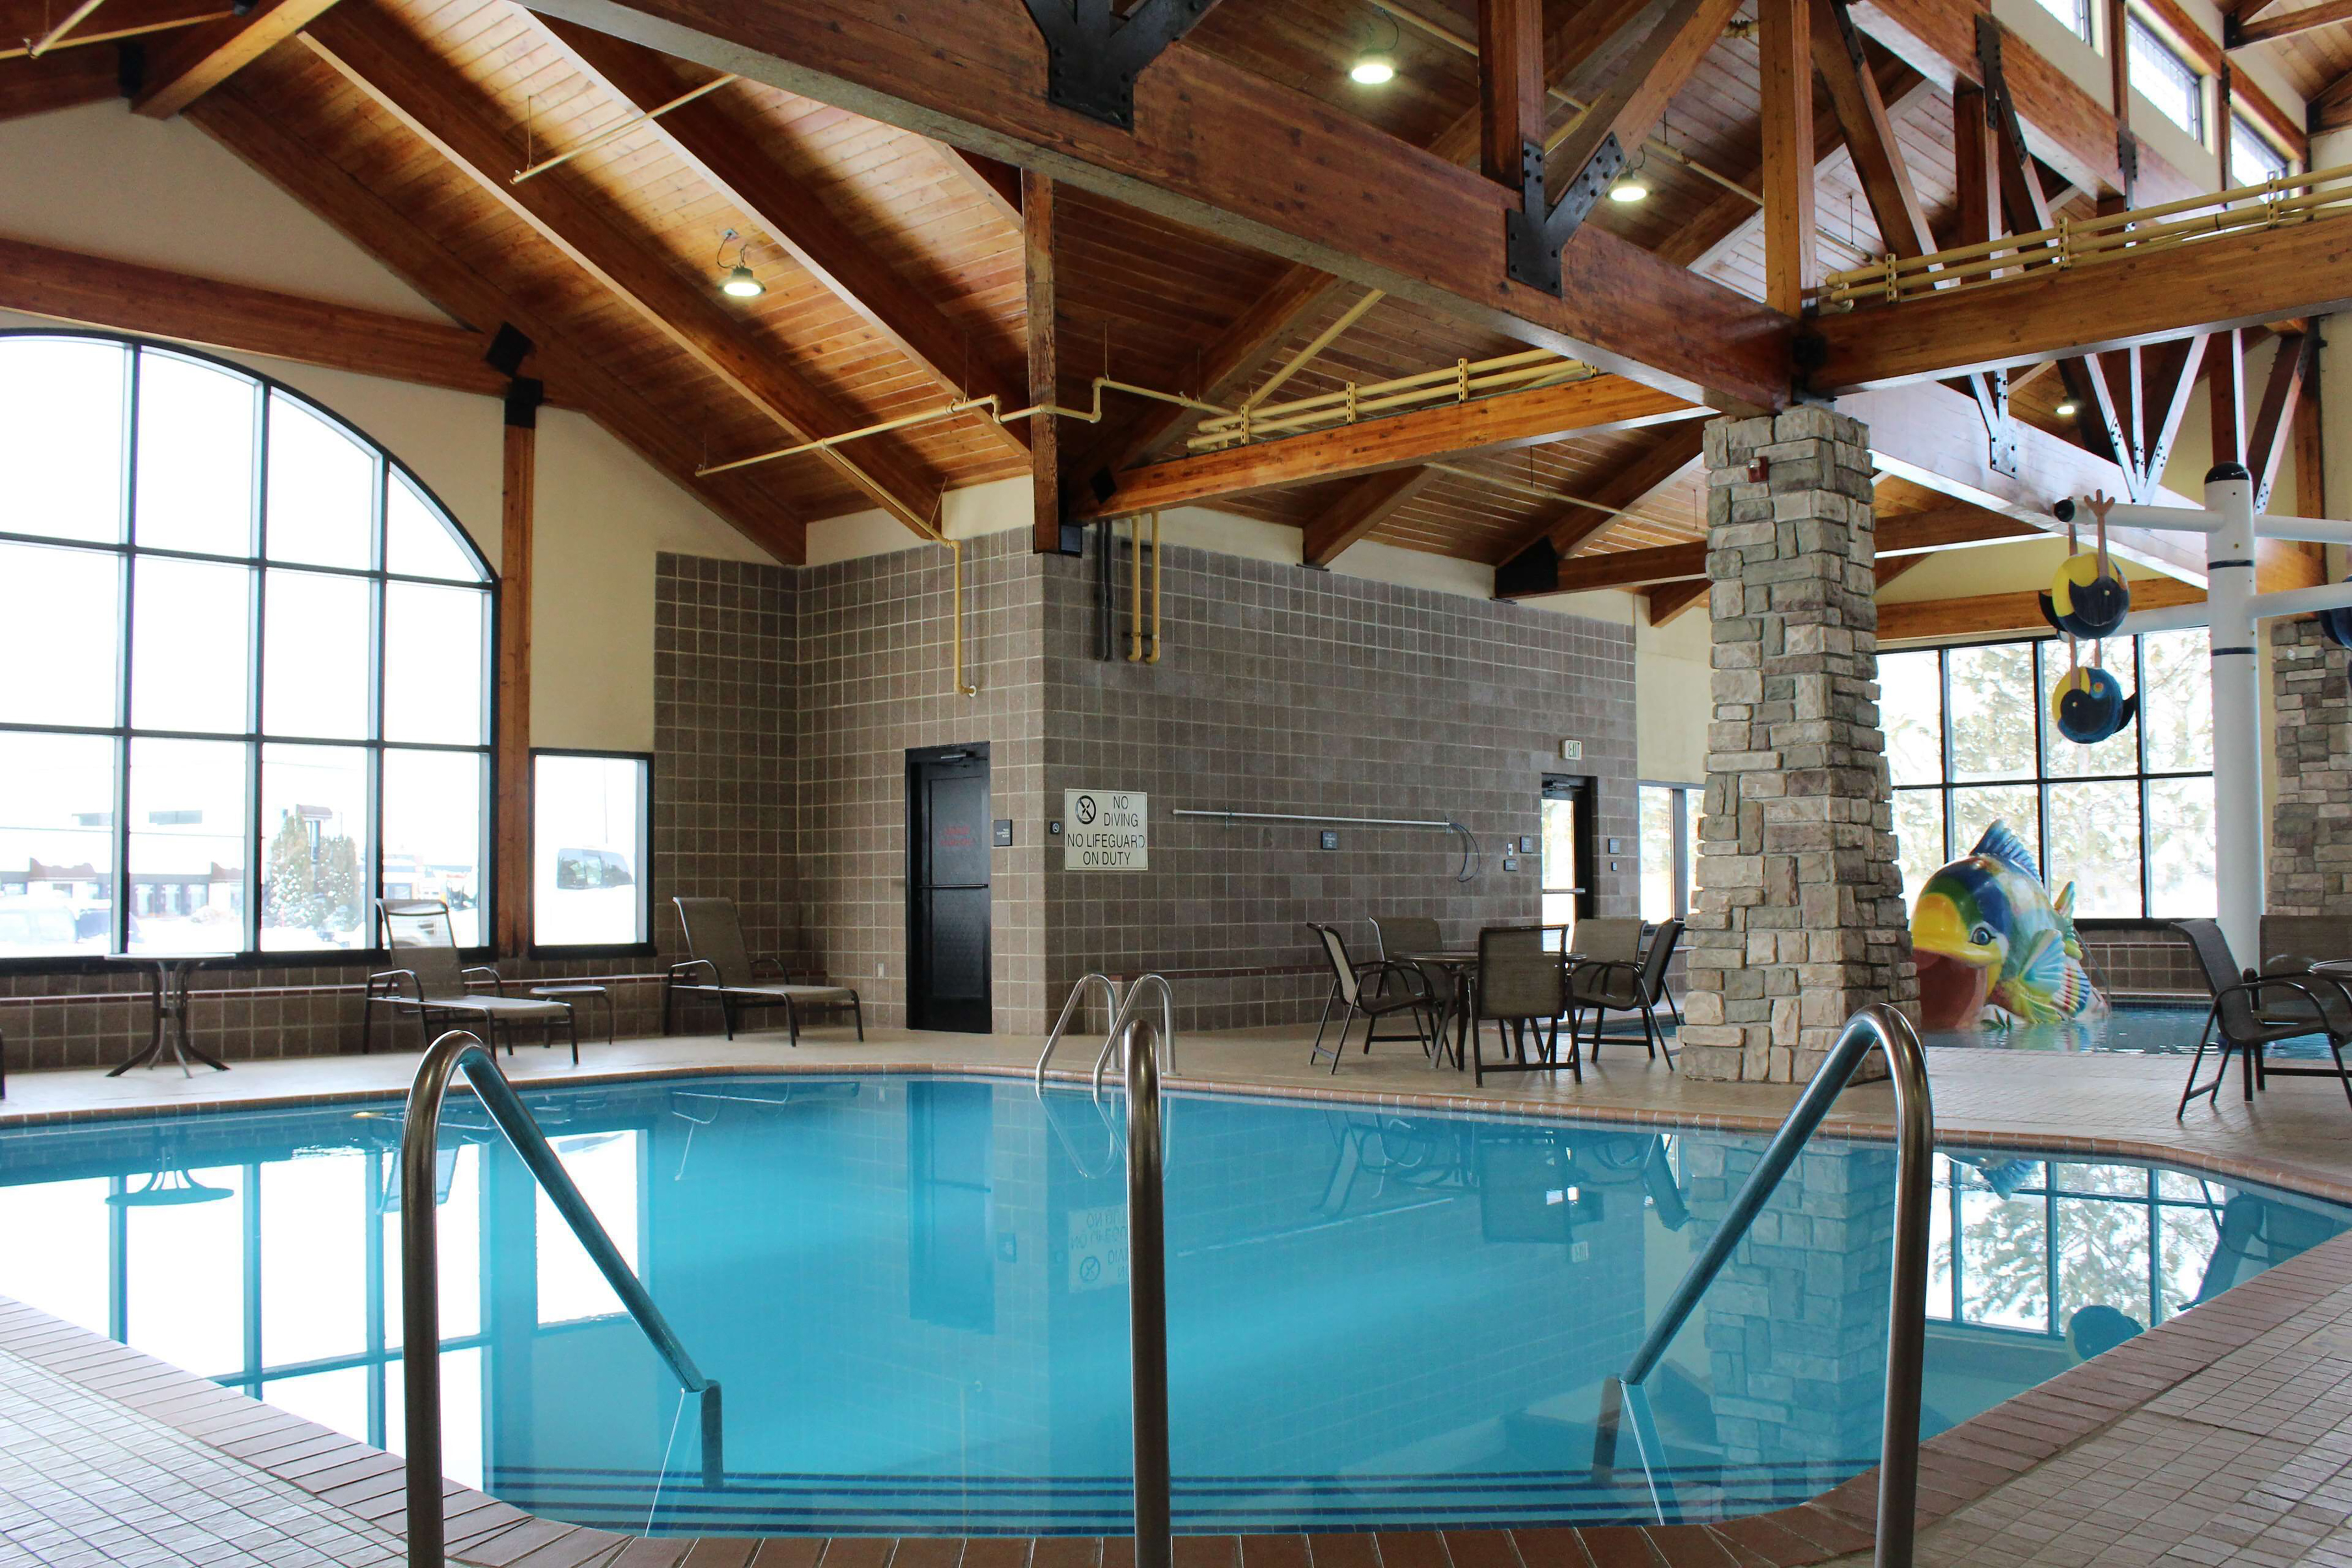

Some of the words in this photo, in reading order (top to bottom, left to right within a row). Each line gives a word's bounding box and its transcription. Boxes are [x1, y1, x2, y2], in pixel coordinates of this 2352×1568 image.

[1568, 742, 1579, 758] EXIT
[1113, 795, 1129, 810] NO
[1104, 812, 1138, 827] DIVING
[1067, 833, 1083, 847] NO
[1087, 834, 1145, 848] LIFEGUARD
[1083, 851, 1099, 865] ON
[1102, 851, 1131, 866] DUTY
